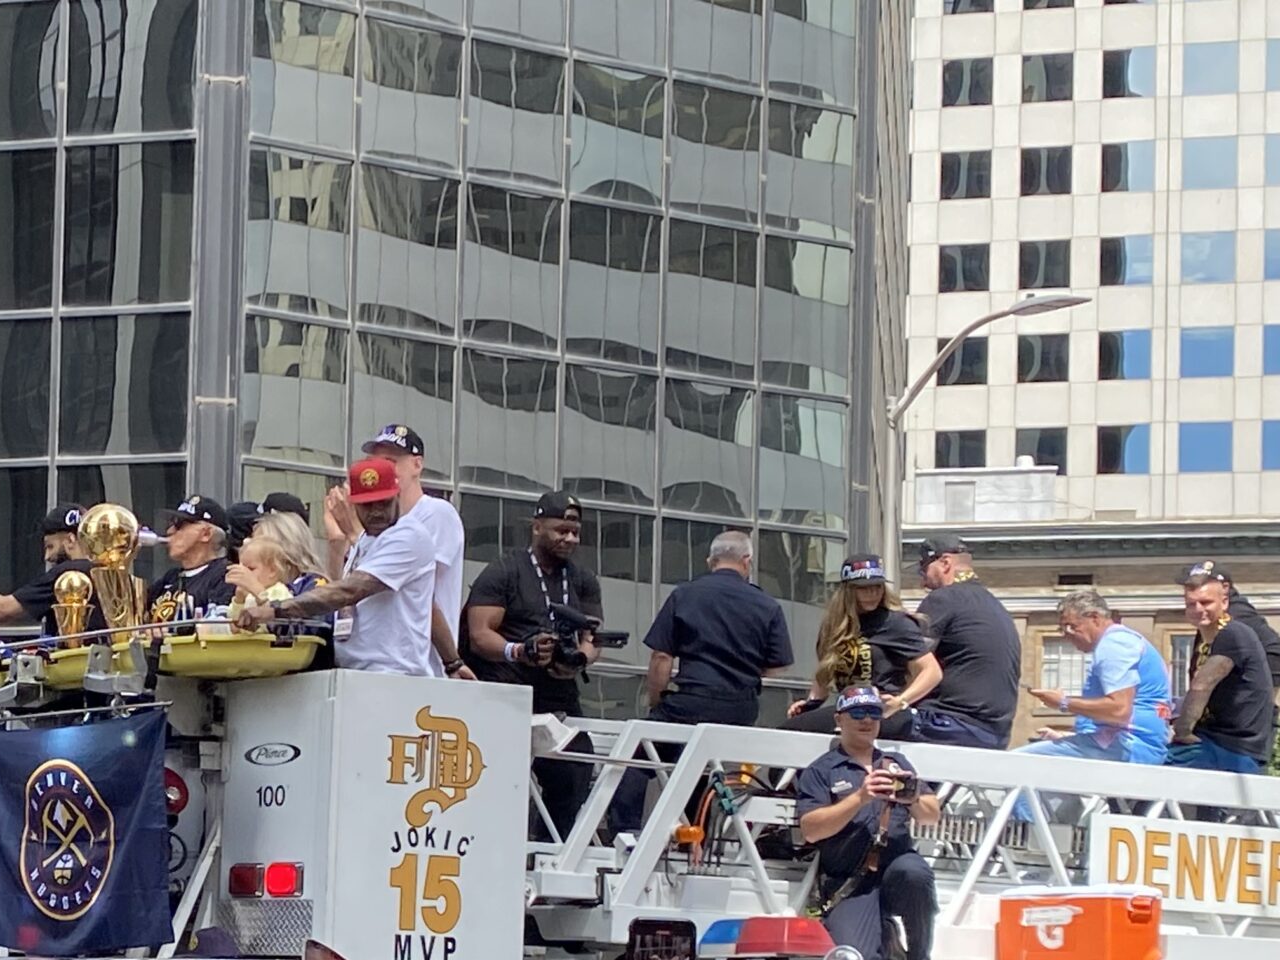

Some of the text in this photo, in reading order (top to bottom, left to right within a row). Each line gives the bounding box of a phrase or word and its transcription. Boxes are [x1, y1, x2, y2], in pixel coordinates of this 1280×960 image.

[256, 785, 286, 808] 100
[29, 866, 102, 910] NUGGETS
[390, 853, 462, 935] 15
